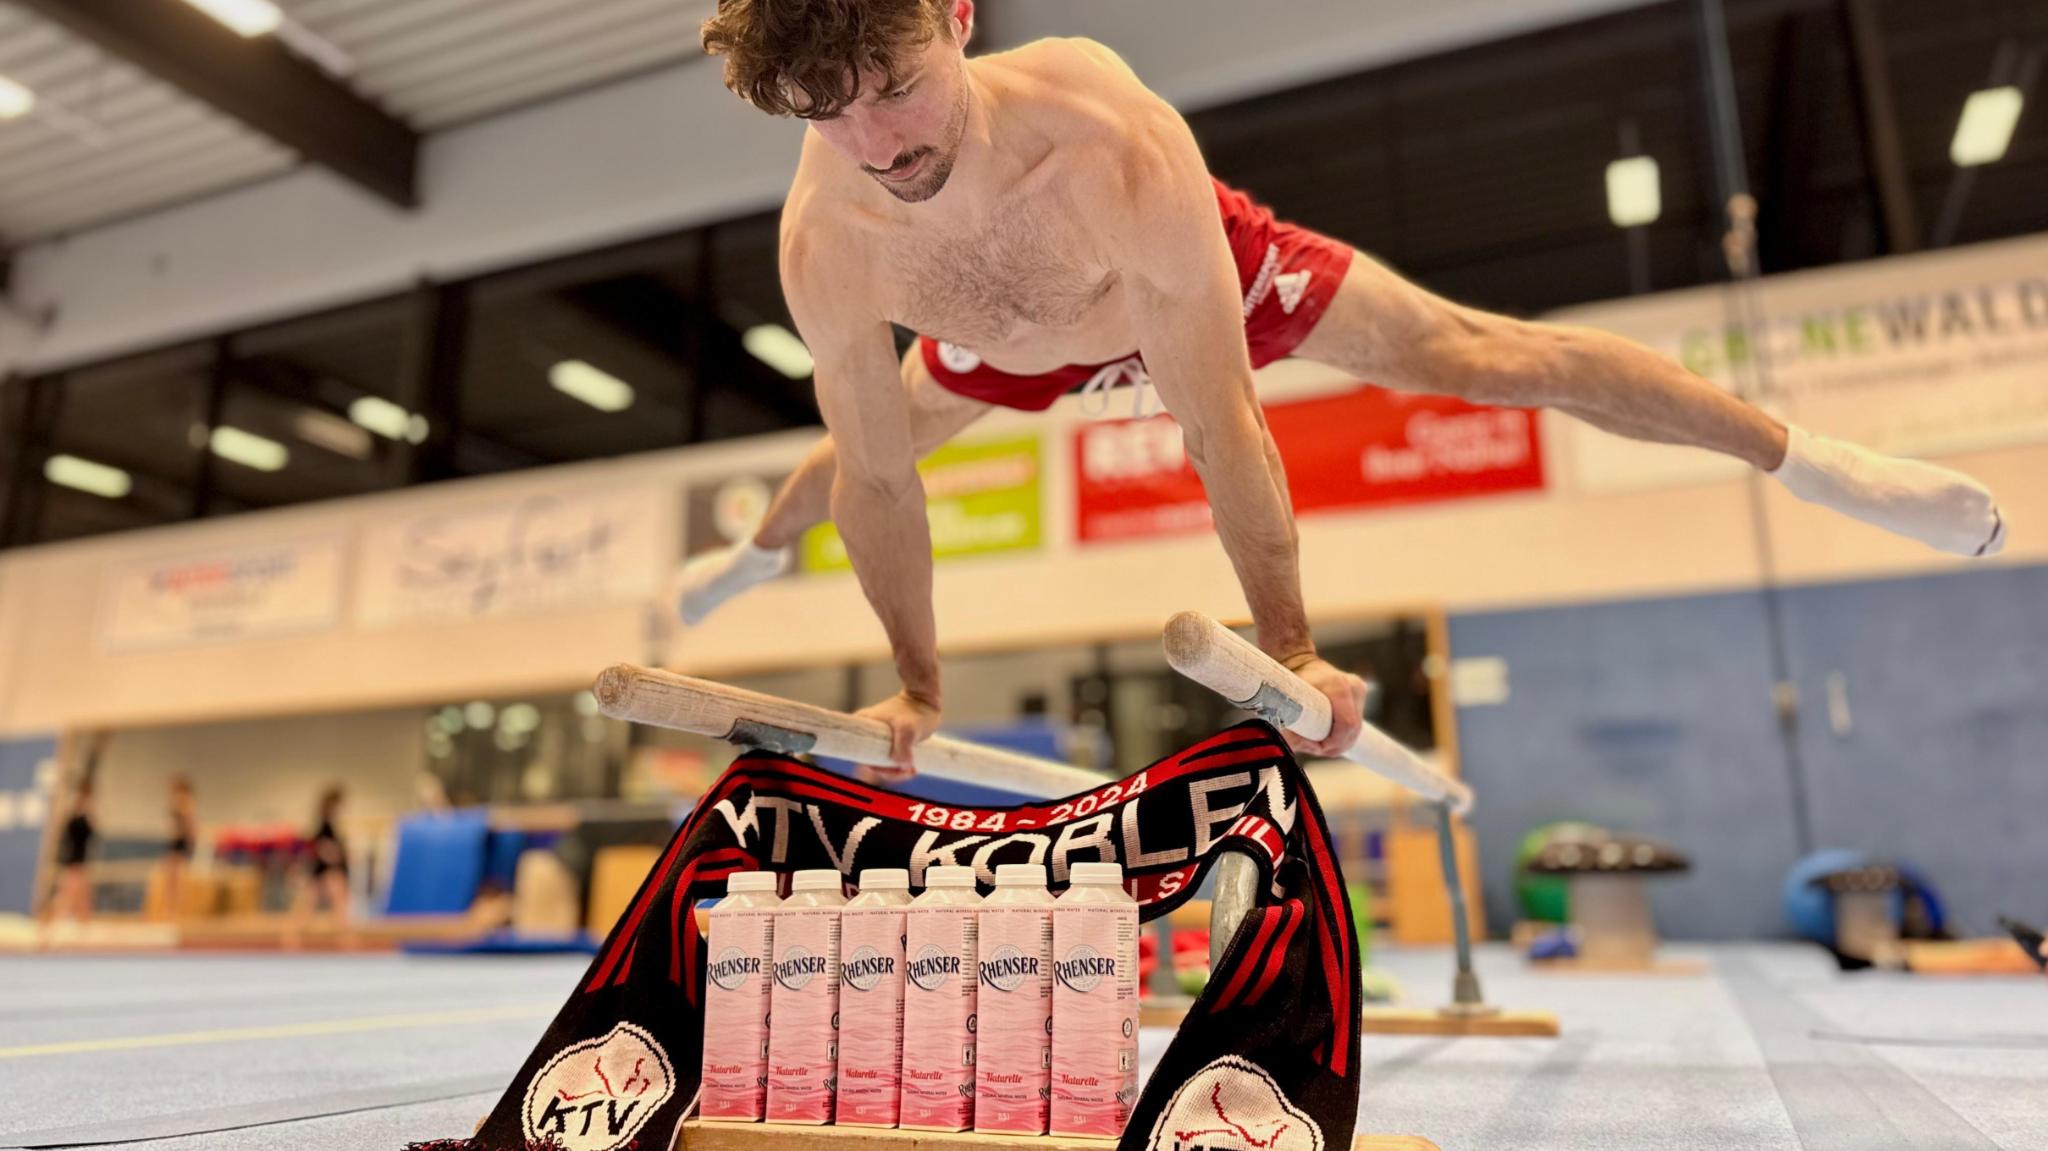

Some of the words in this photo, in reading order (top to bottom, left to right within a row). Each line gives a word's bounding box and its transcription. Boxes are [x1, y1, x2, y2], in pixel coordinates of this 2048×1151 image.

[908, 803, 1007, 831] 1984
[1046, 772, 1148, 826] 2024
[707, 957, 760, 991] RHENSER
[773, 956, 826, 991] RHENSER
[841, 957, 894, 992] RHENSER
[906, 956, 960, 991] RHENSER
[978, 957, 1039, 992] RHENSER
[1053, 957, 1115, 993] RHENSER
[709, 1064, 742, 1074] Naturelle
[776, 1066, 809, 1076] Naturelle
[845, 1068, 878, 1079] Naturelle
[910, 1069, 943, 1080] Naturelle
[986, 1072, 1024, 1083] Naturelle
[1062, 1074, 1100, 1087] Naturelle
[537, 1096, 641, 1136] KTV
